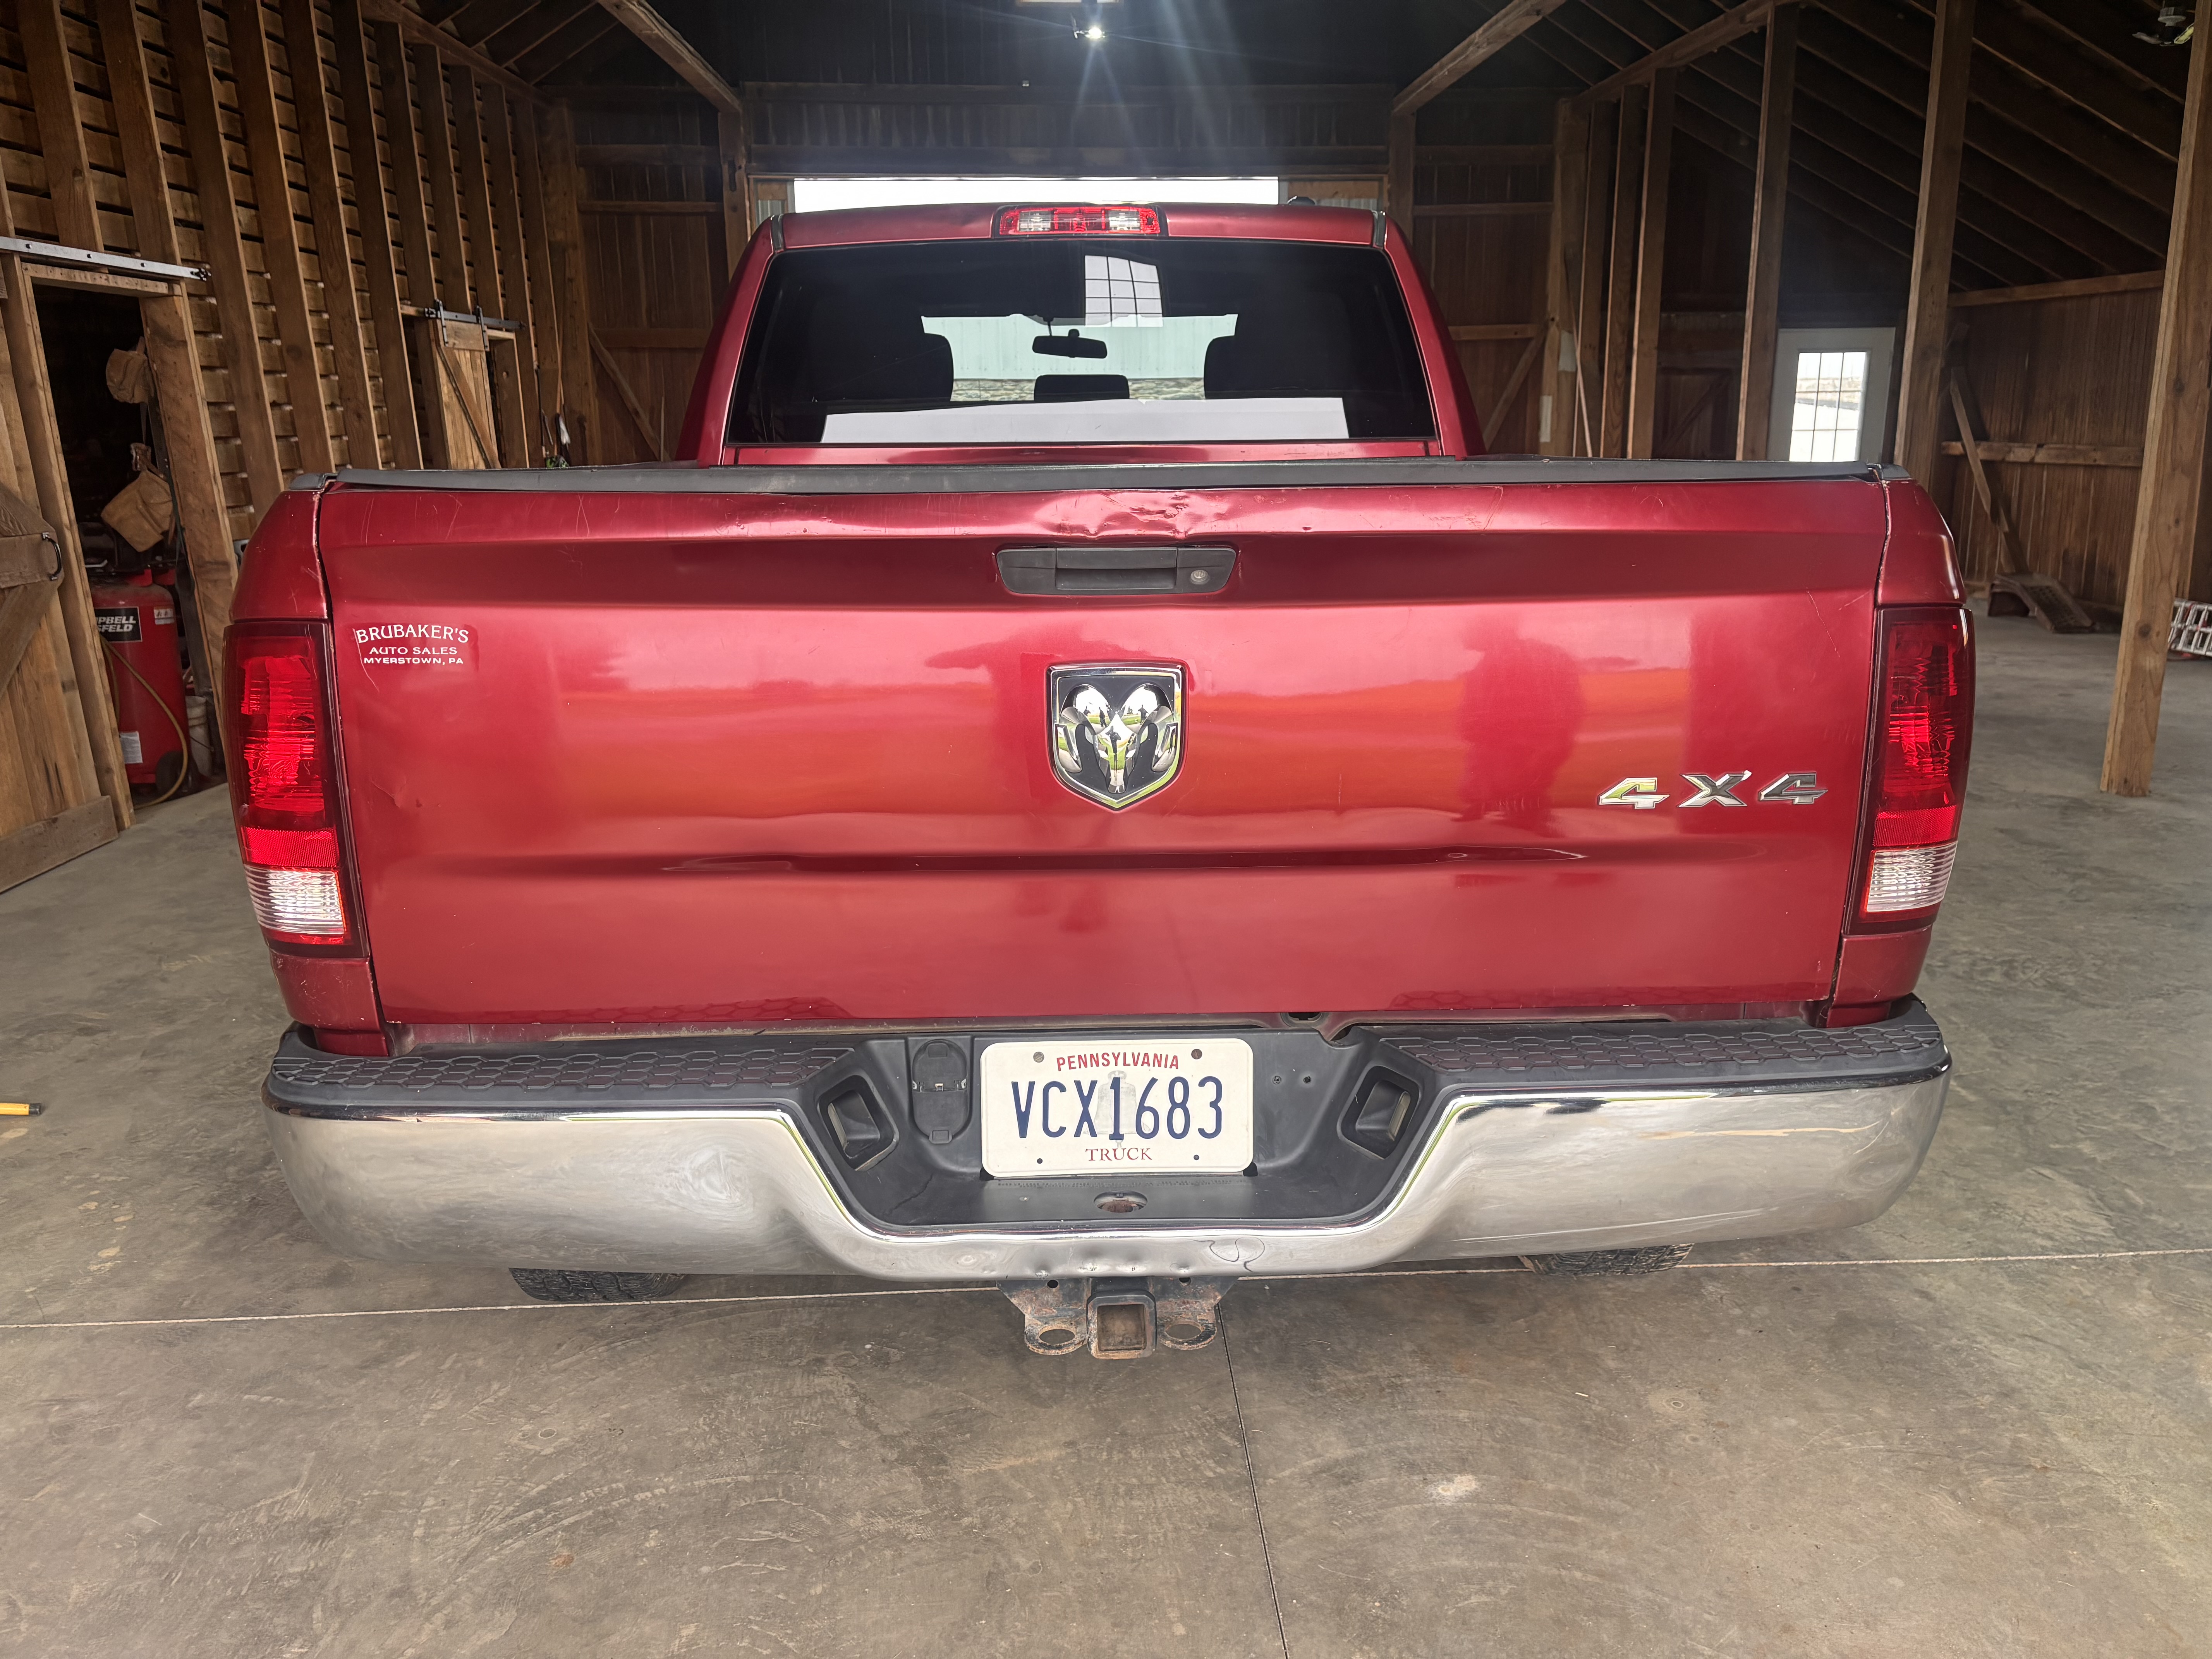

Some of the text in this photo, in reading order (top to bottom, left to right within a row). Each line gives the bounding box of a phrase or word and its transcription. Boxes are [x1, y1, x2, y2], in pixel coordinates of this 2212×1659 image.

[356, 624, 469, 643] BRUBAKER'S
[364, 657, 445, 665] MYERSTOWN,
[1056, 1052, 1179, 1072] PENNSYLVANIA
[1011, 1076, 1223, 1140] VCX1683
[1085, 1147, 1152, 1161] TRUCK
